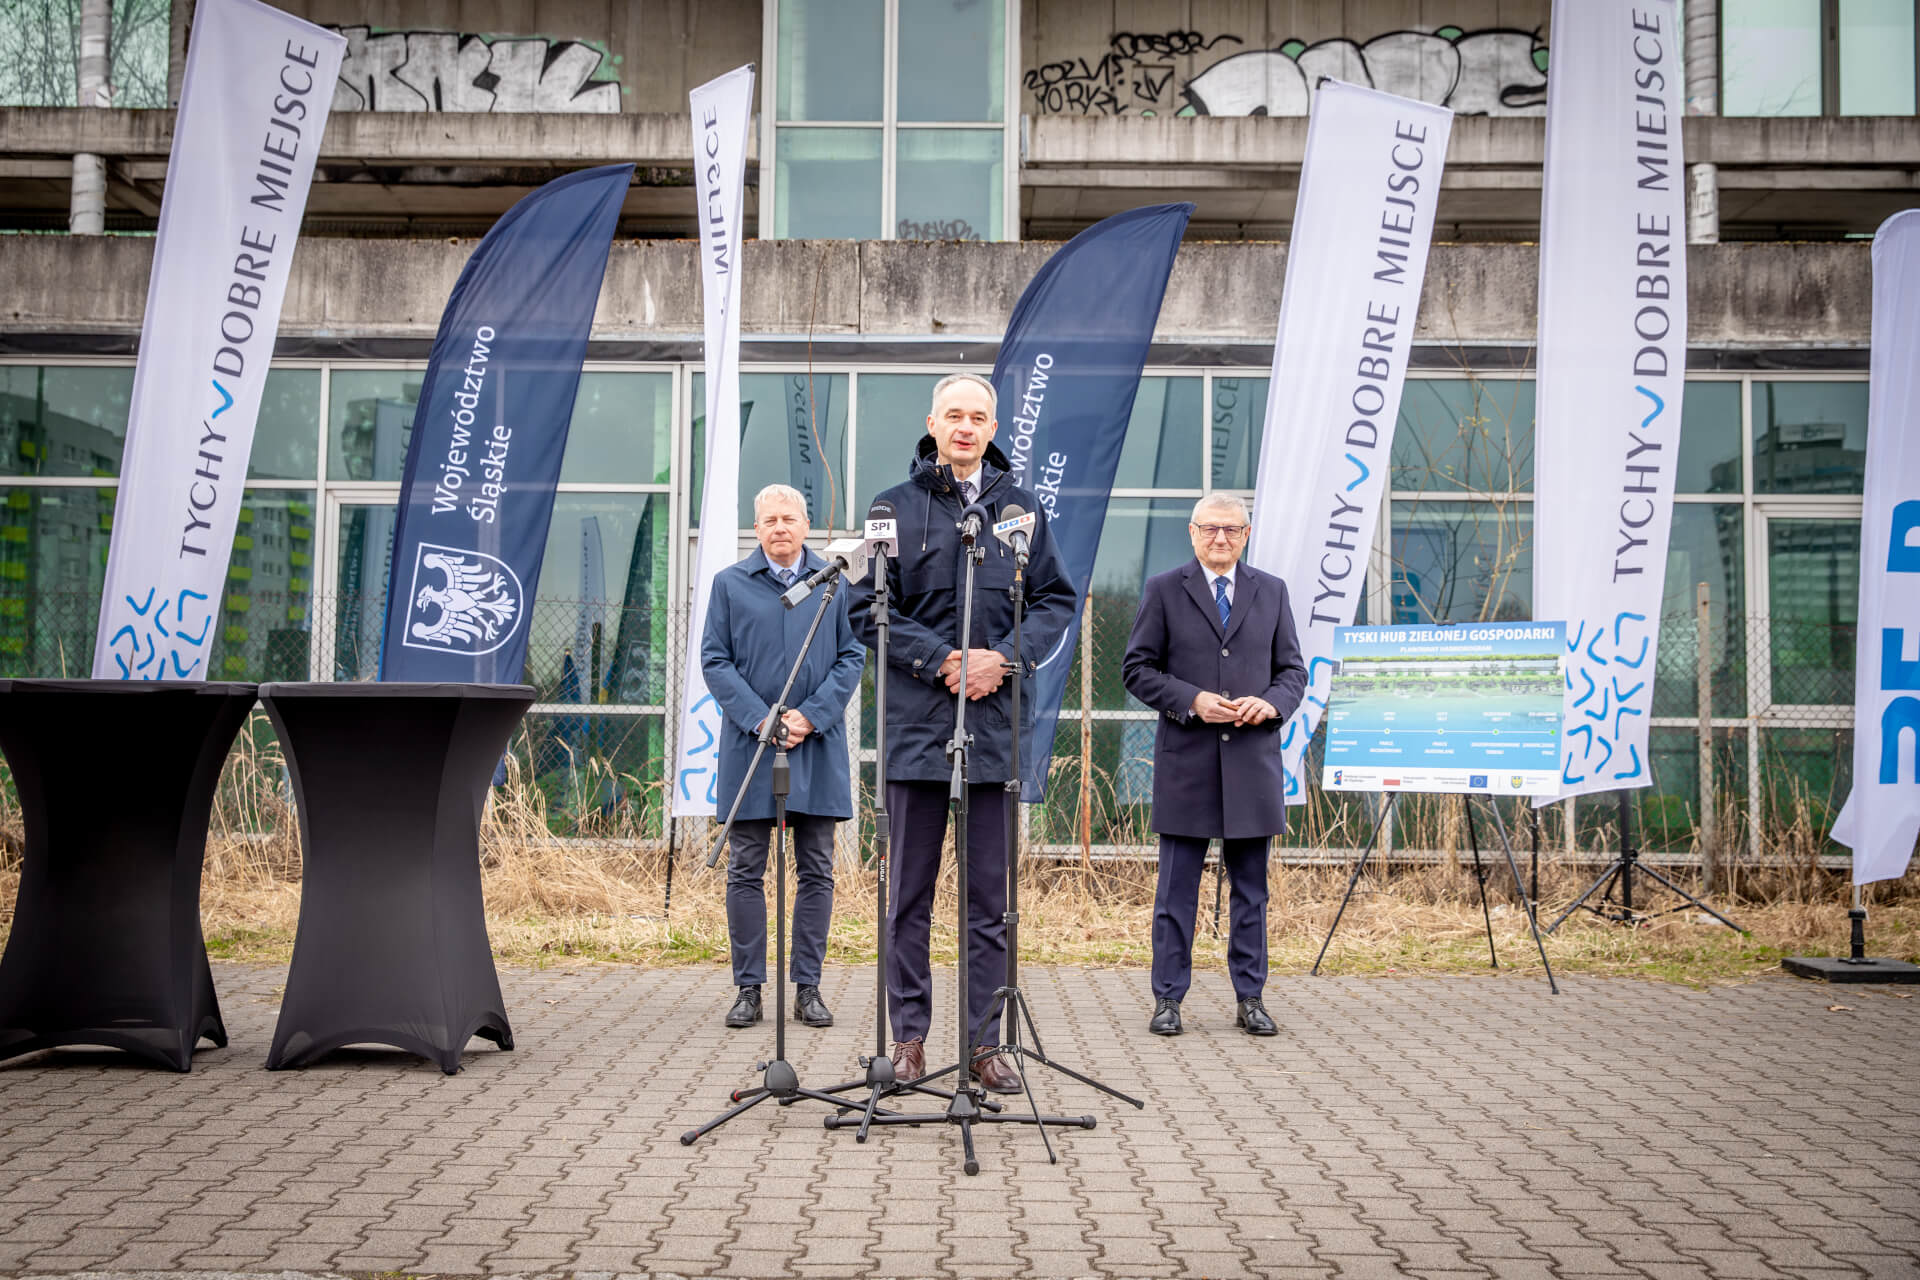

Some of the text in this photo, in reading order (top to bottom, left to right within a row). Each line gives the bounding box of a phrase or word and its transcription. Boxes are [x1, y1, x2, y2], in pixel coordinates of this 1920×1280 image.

[179, 39, 319, 559] TYCHY DOBRE MIEJSCE
[1309, 119, 1427, 628] TYCHY DOBRE MIEJSCE
[1613, 7, 1670, 584] TYCHY DOBRE MIEJSCE
[432, 325, 495, 515] Województwo
[466, 425, 512, 524] Śląskie
[1008, 353, 1054, 487] wództwo
[871, 521, 890, 531] SPI
[1344, 627, 1555, 644] TYSKI HUB ZIELONEJ GOSPODARKI
